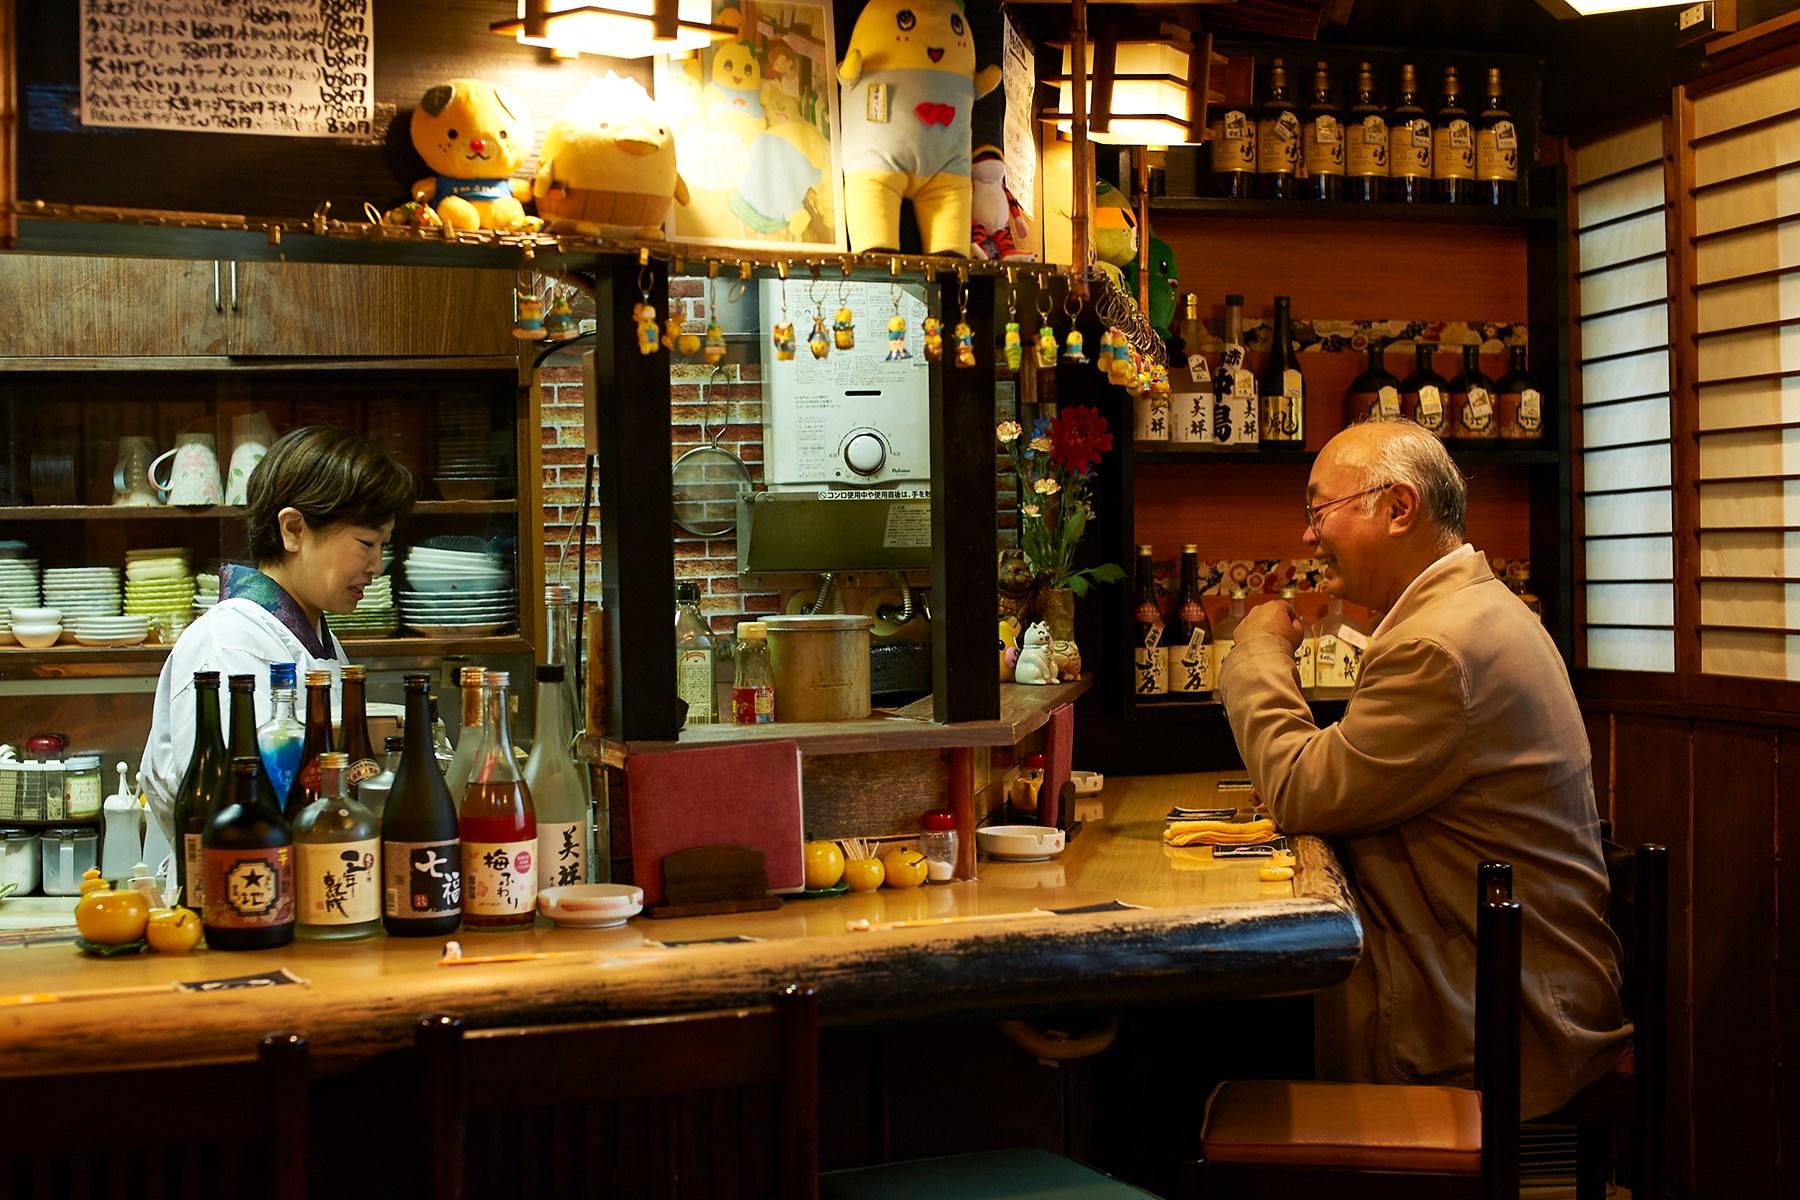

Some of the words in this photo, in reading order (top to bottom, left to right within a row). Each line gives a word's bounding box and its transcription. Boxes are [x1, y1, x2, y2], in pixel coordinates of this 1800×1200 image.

[414, 850, 461, 905] 七福
[483, 848, 519, 909] 梅ふわり
